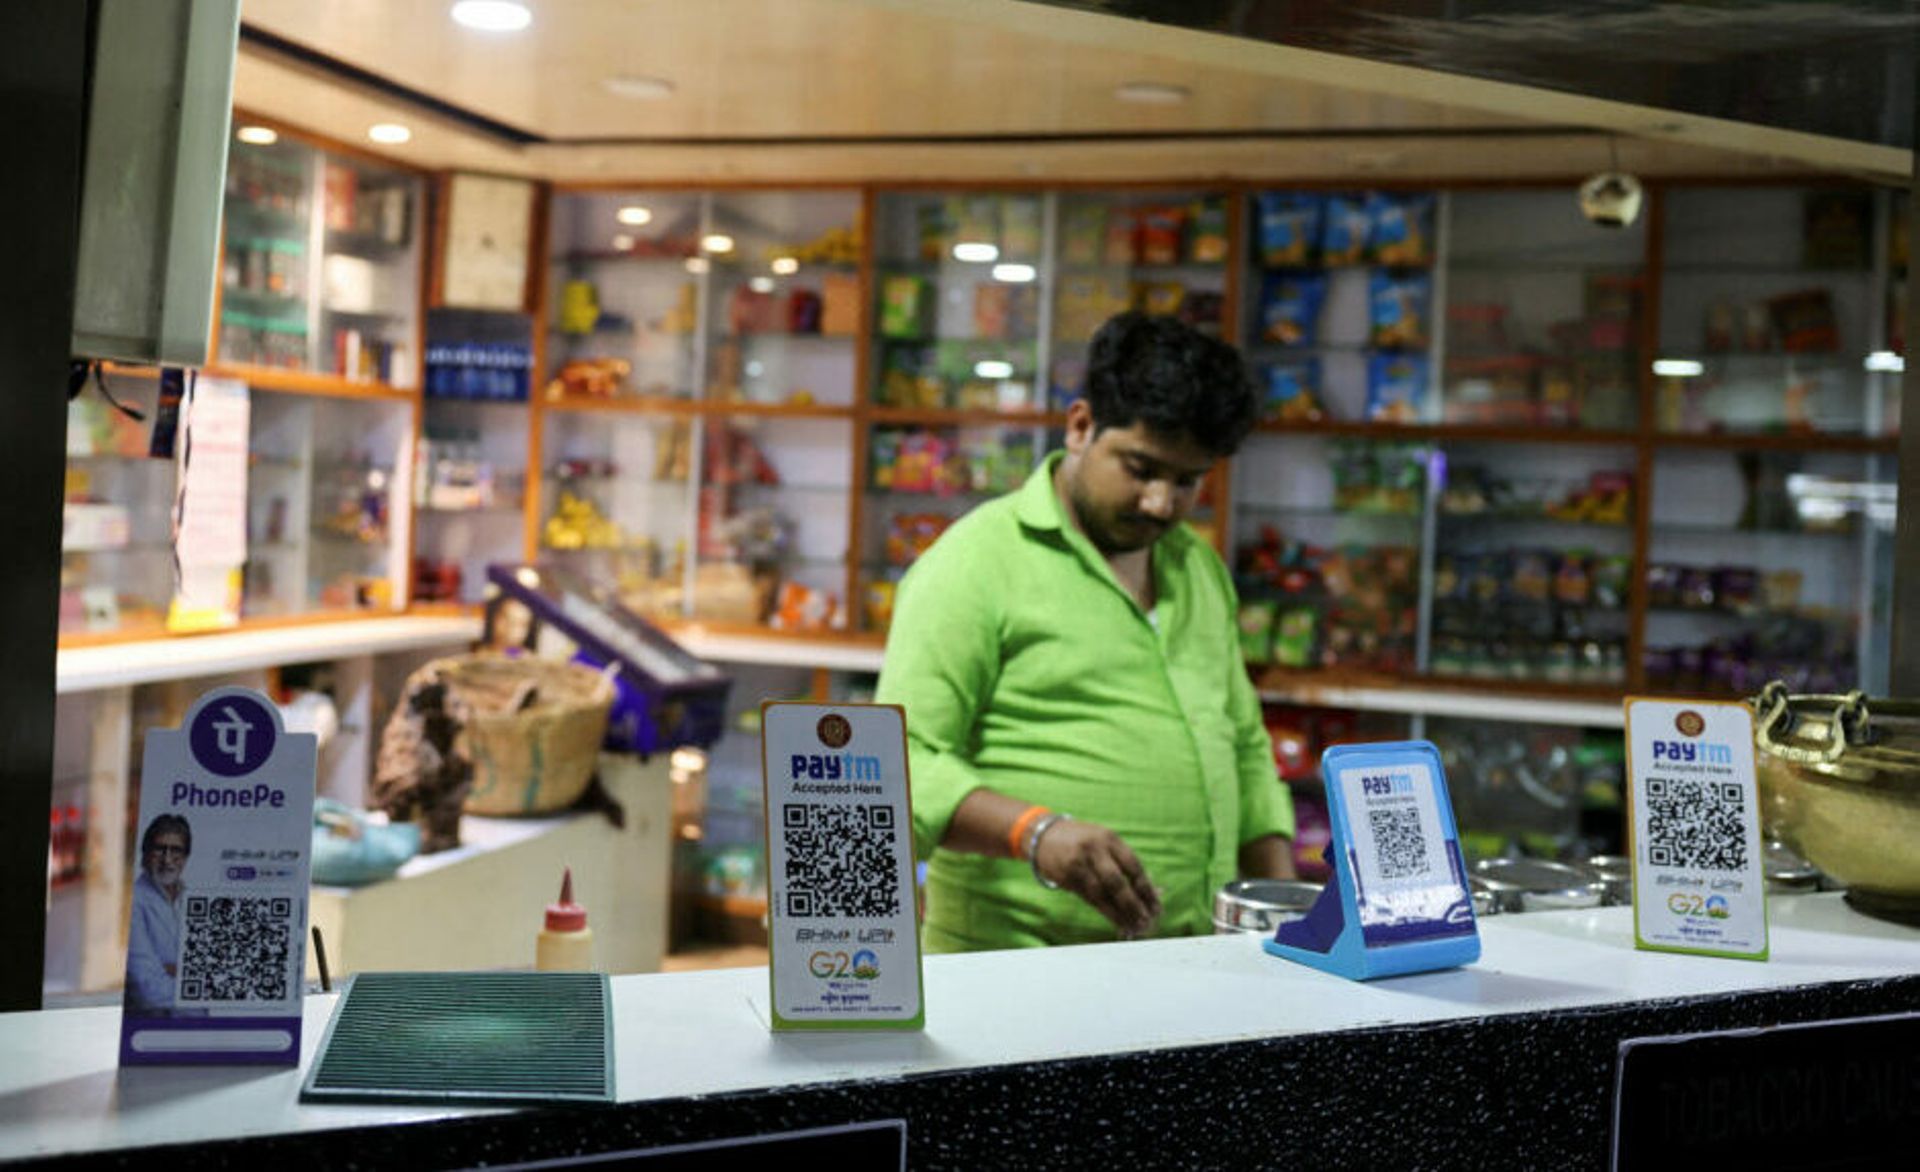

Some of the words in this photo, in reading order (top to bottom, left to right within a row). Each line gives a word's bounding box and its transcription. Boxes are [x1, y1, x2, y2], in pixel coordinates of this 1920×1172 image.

[211, 706, 253, 764] पे
[171, 782, 286, 808] PhonePe
[791, 782, 851, 795] Accepted
[853, 783, 883, 795] Here
